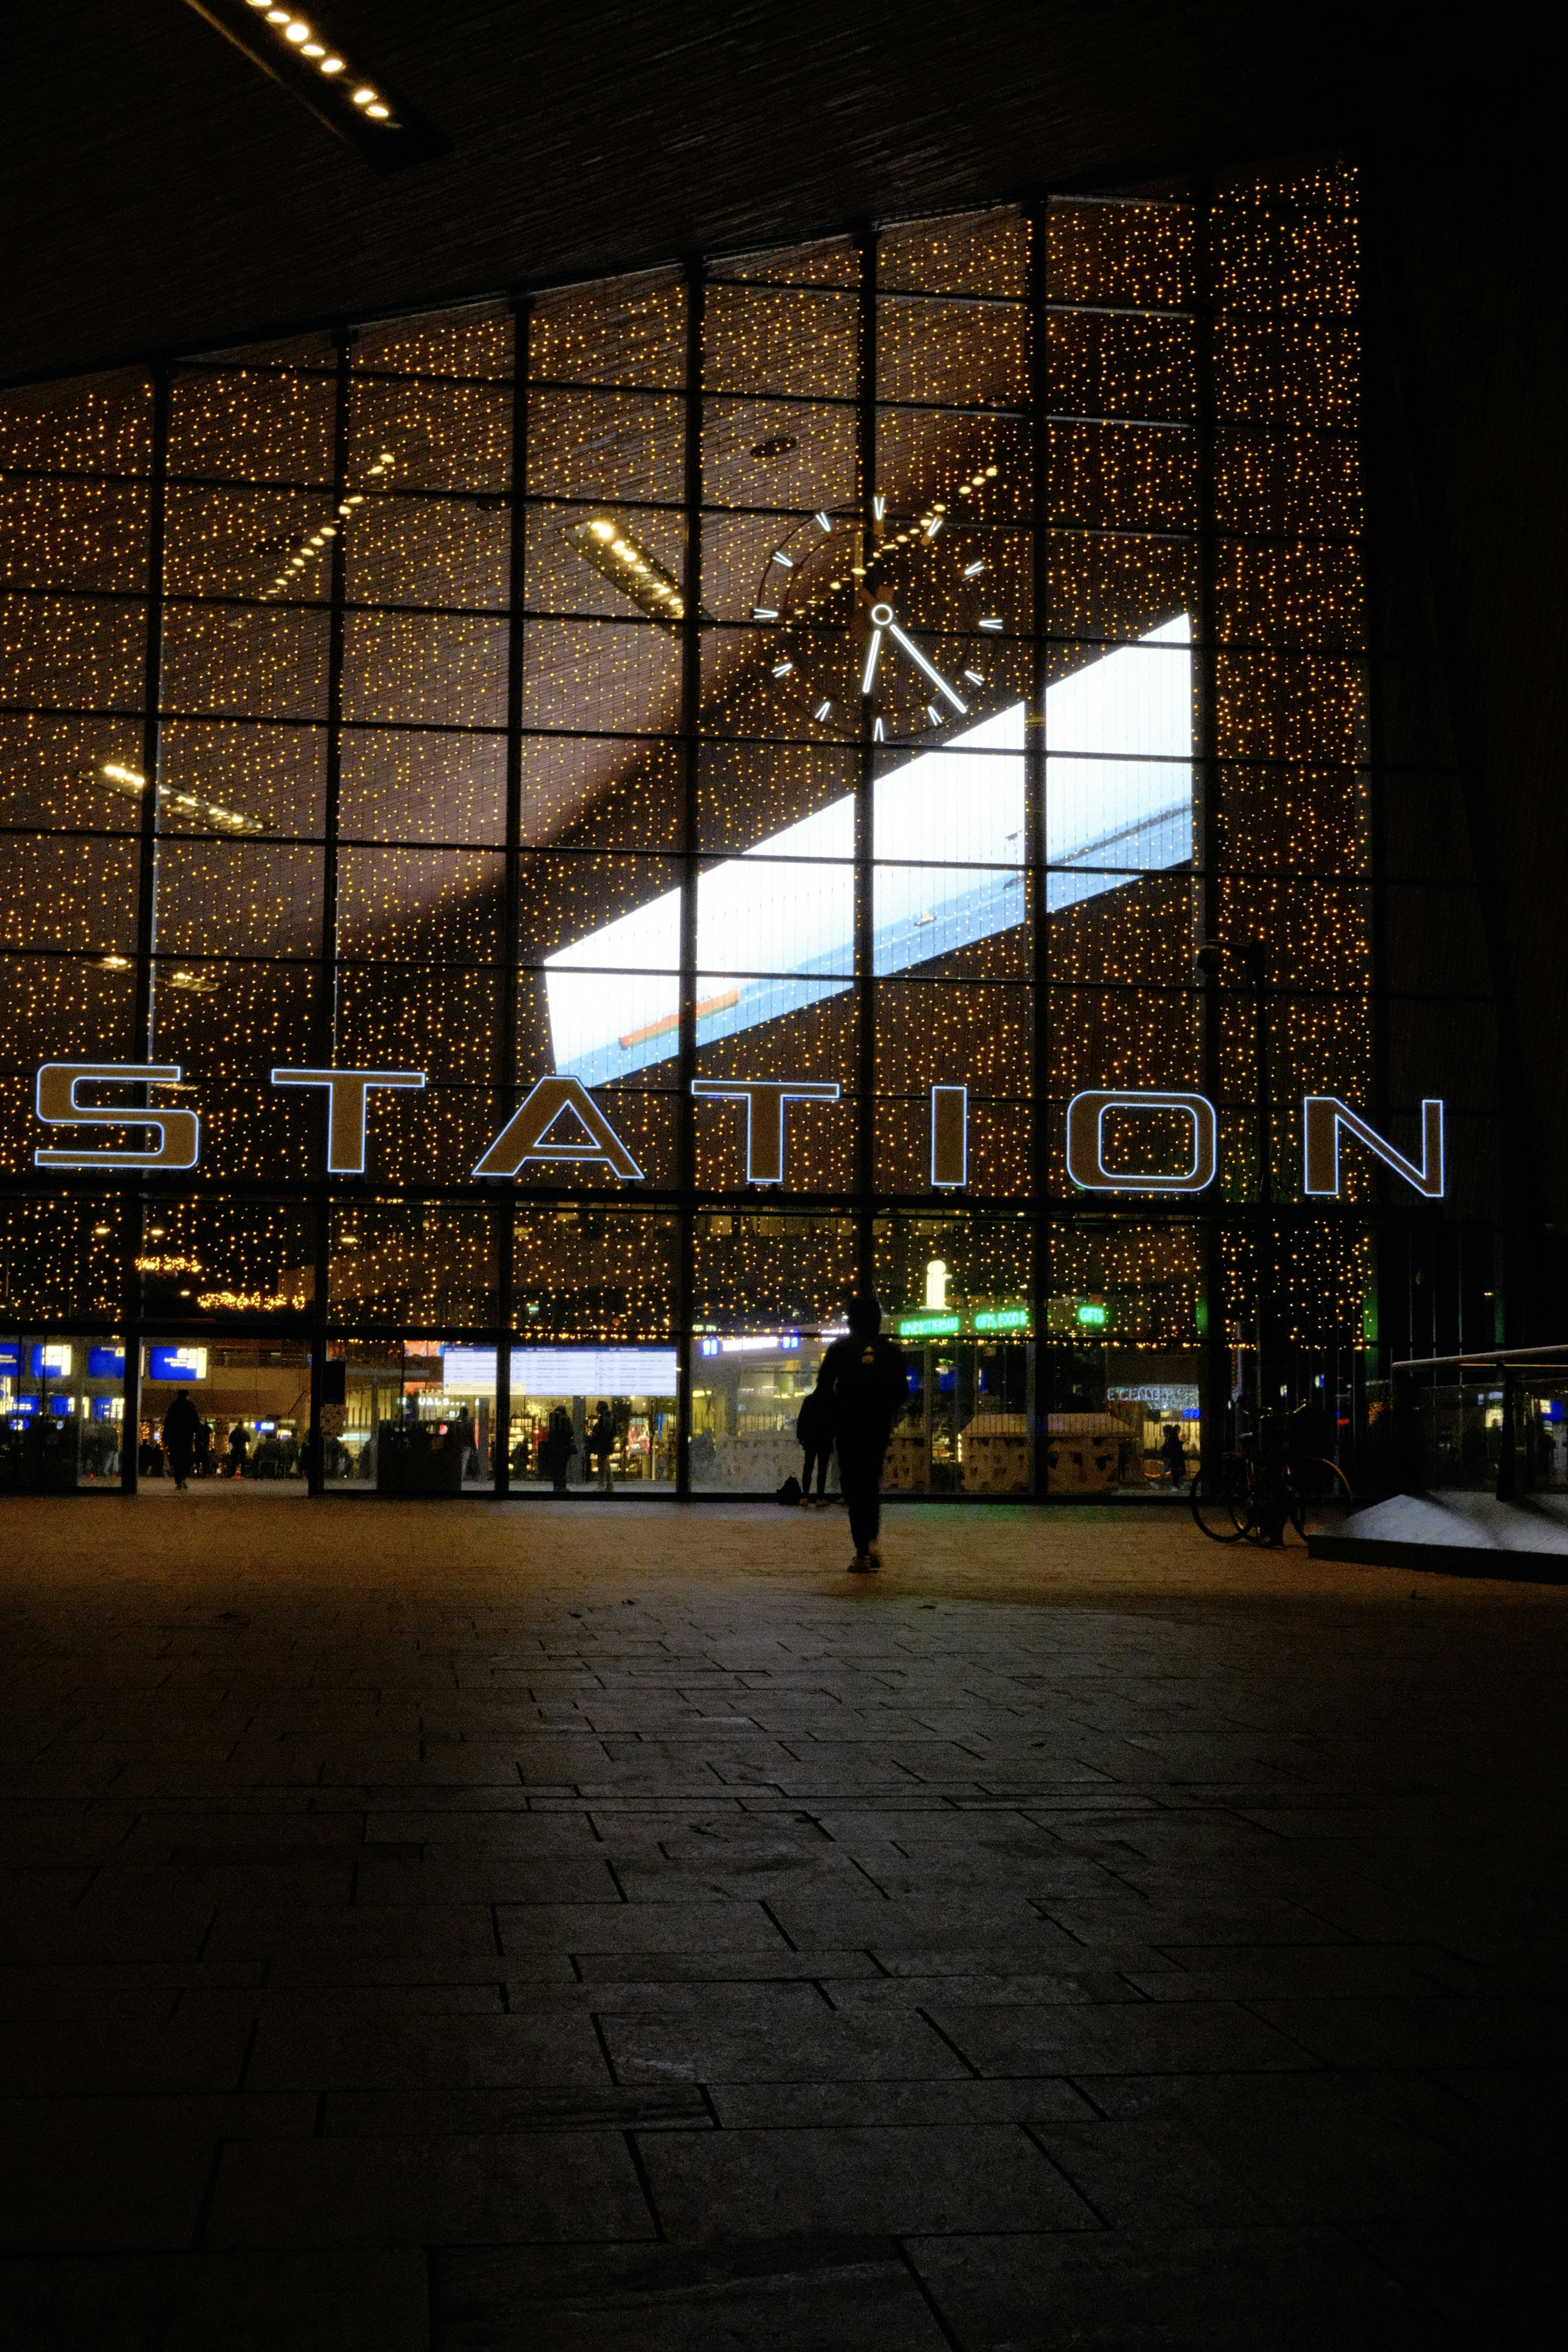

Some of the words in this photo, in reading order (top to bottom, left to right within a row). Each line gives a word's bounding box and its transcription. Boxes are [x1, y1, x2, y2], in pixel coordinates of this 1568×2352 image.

[34, 1062, 1444, 1198] STATION
[998, 1311, 1019, 1327] FOOD
[1079, 1307, 1104, 1323] GIFTS
[919, 1317, 959, 1333] ROTTERDAM
